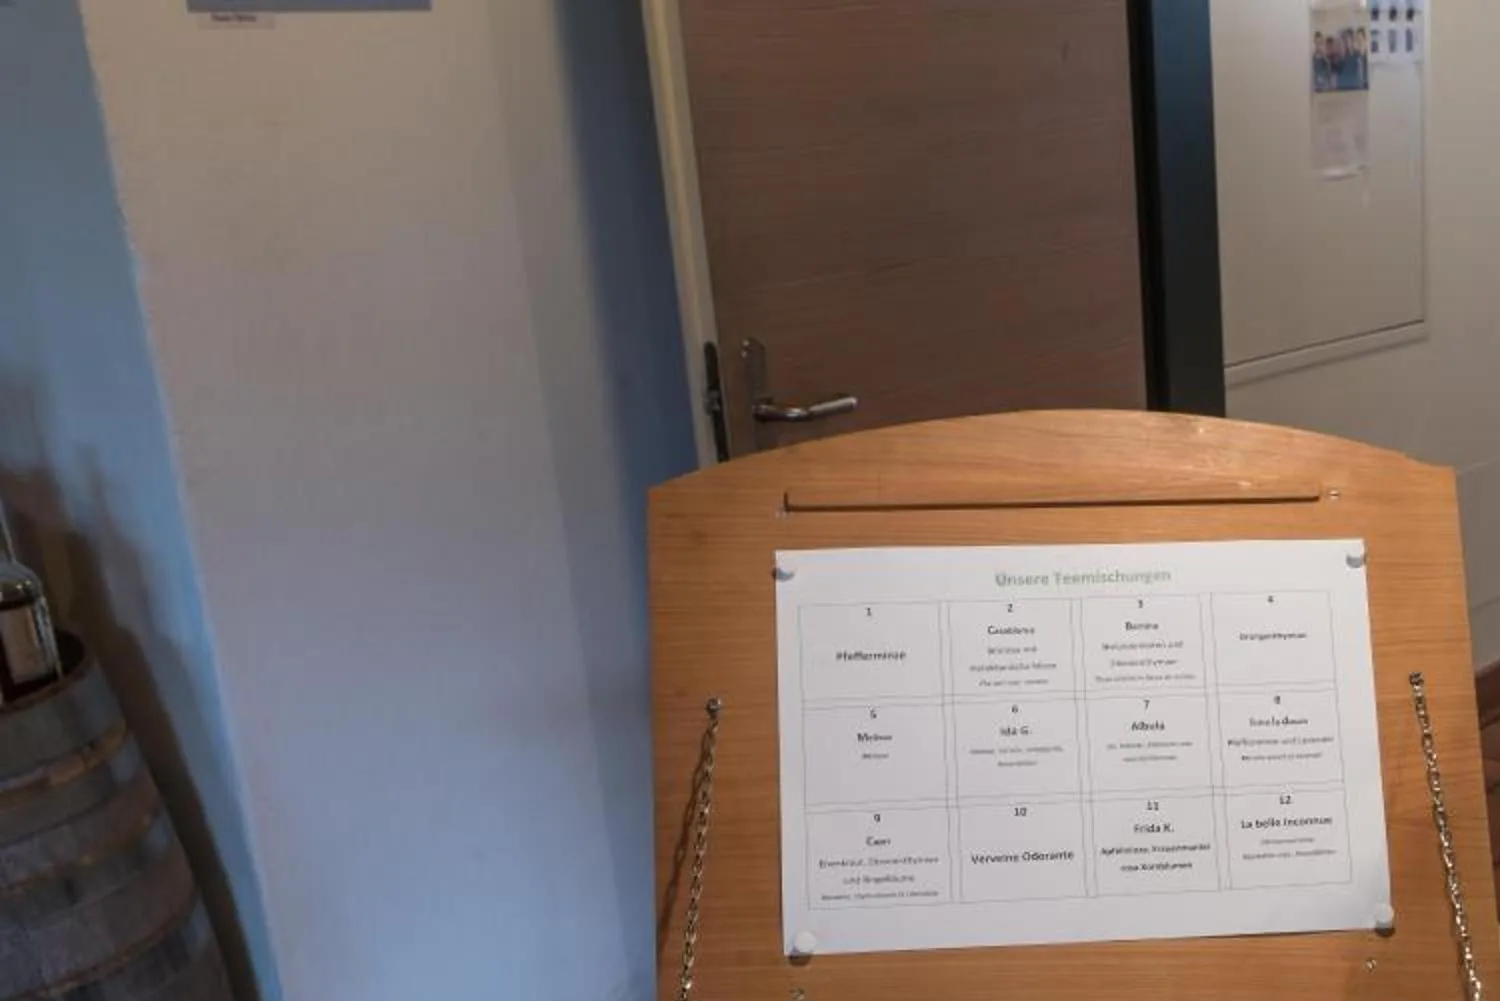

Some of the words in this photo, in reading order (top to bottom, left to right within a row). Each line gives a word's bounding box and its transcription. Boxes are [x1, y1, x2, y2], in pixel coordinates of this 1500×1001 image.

[994, 572, 1049, 587] Unsere
[1054, 569, 1172, 587] Teemischungen
[866, 607, 872, 617] 1
[1007, 603, 1013, 613] 2
[836, 650, 907, 662] Pfefferminze
[1011, 704, 1018, 714] 6
[1144, 700, 1150, 710] 7
[870, 709, 877, 719] 5
[1279, 795, 1291, 805] 12
[1146, 801, 1159, 811] 11
[1013, 807, 1027, 817] 10
[874, 813, 881, 823] 9
[1133, 824, 1155, 833] Frida
[1241, 820, 1253, 829] La
[1255, 818, 1280, 829] belle
[1021, 850, 1075, 862] Odorante
